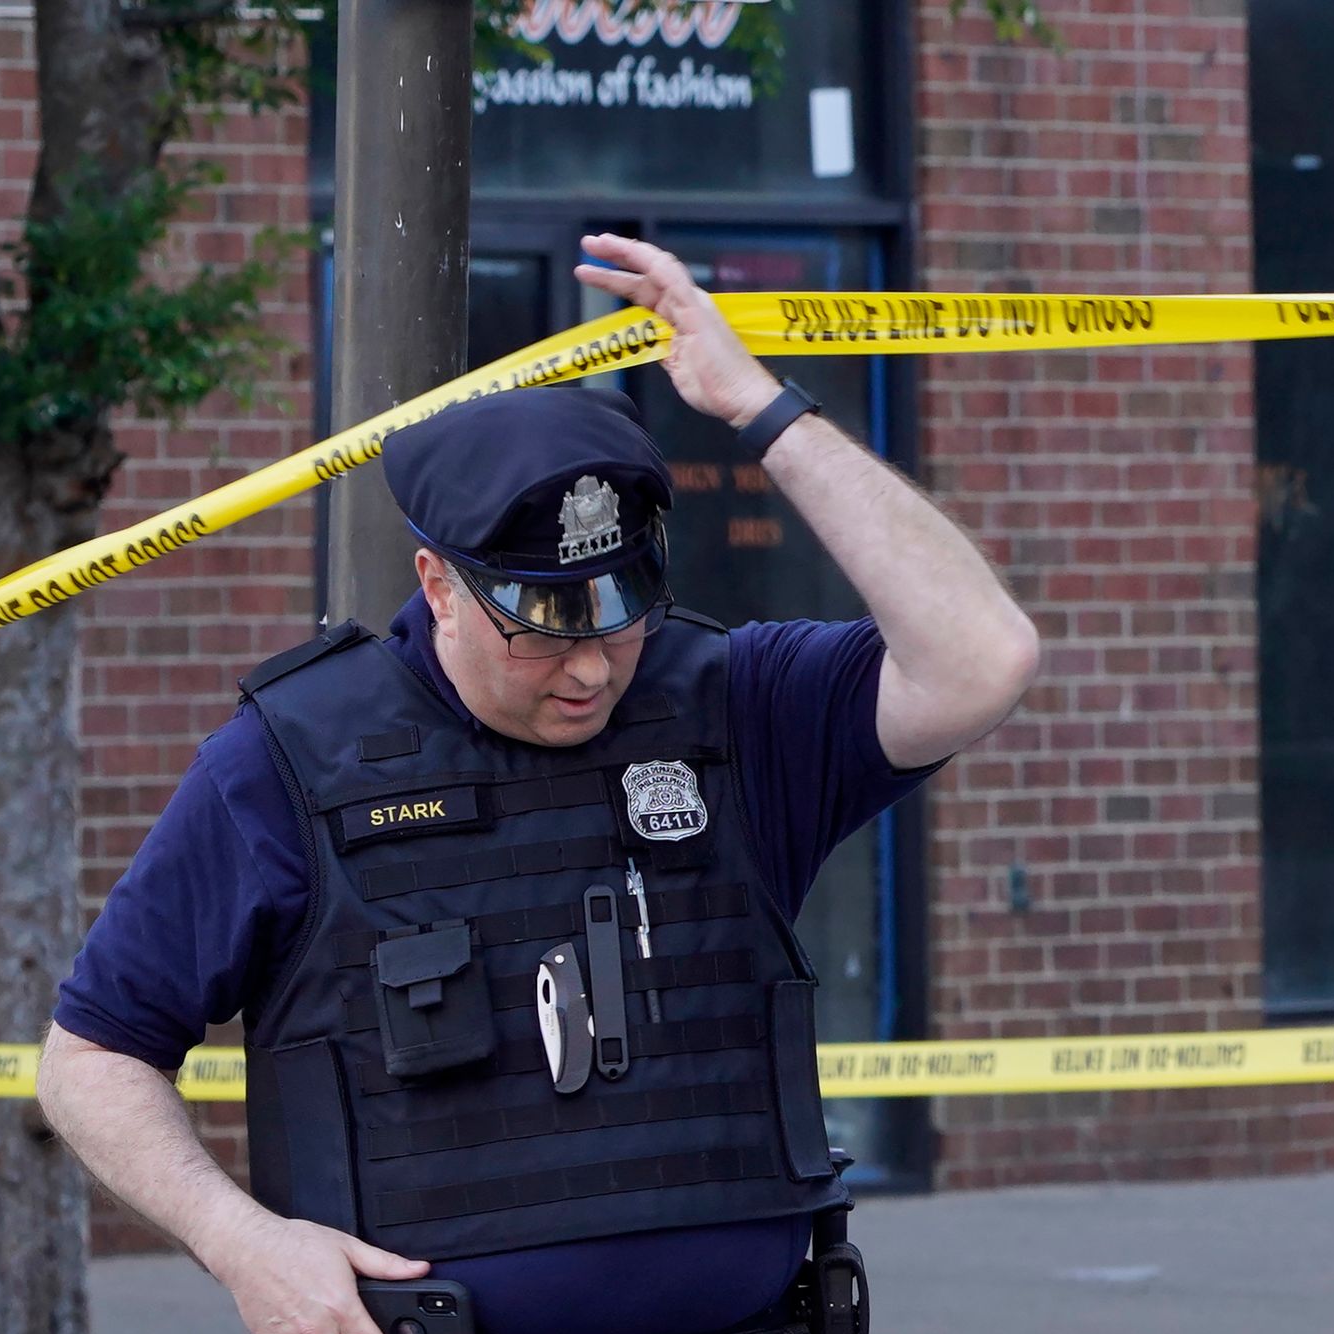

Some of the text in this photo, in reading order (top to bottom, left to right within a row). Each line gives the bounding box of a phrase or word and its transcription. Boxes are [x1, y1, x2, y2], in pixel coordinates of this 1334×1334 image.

[598, 54, 636, 107] of
[635, 54, 754, 111] fashion
[650, 765, 691, 780] DEPARTMENT
[637, 775, 687, 791] PHILADELPHIA
[369, 799, 446, 827] STARK
[648, 811, 695, 831] 6411
